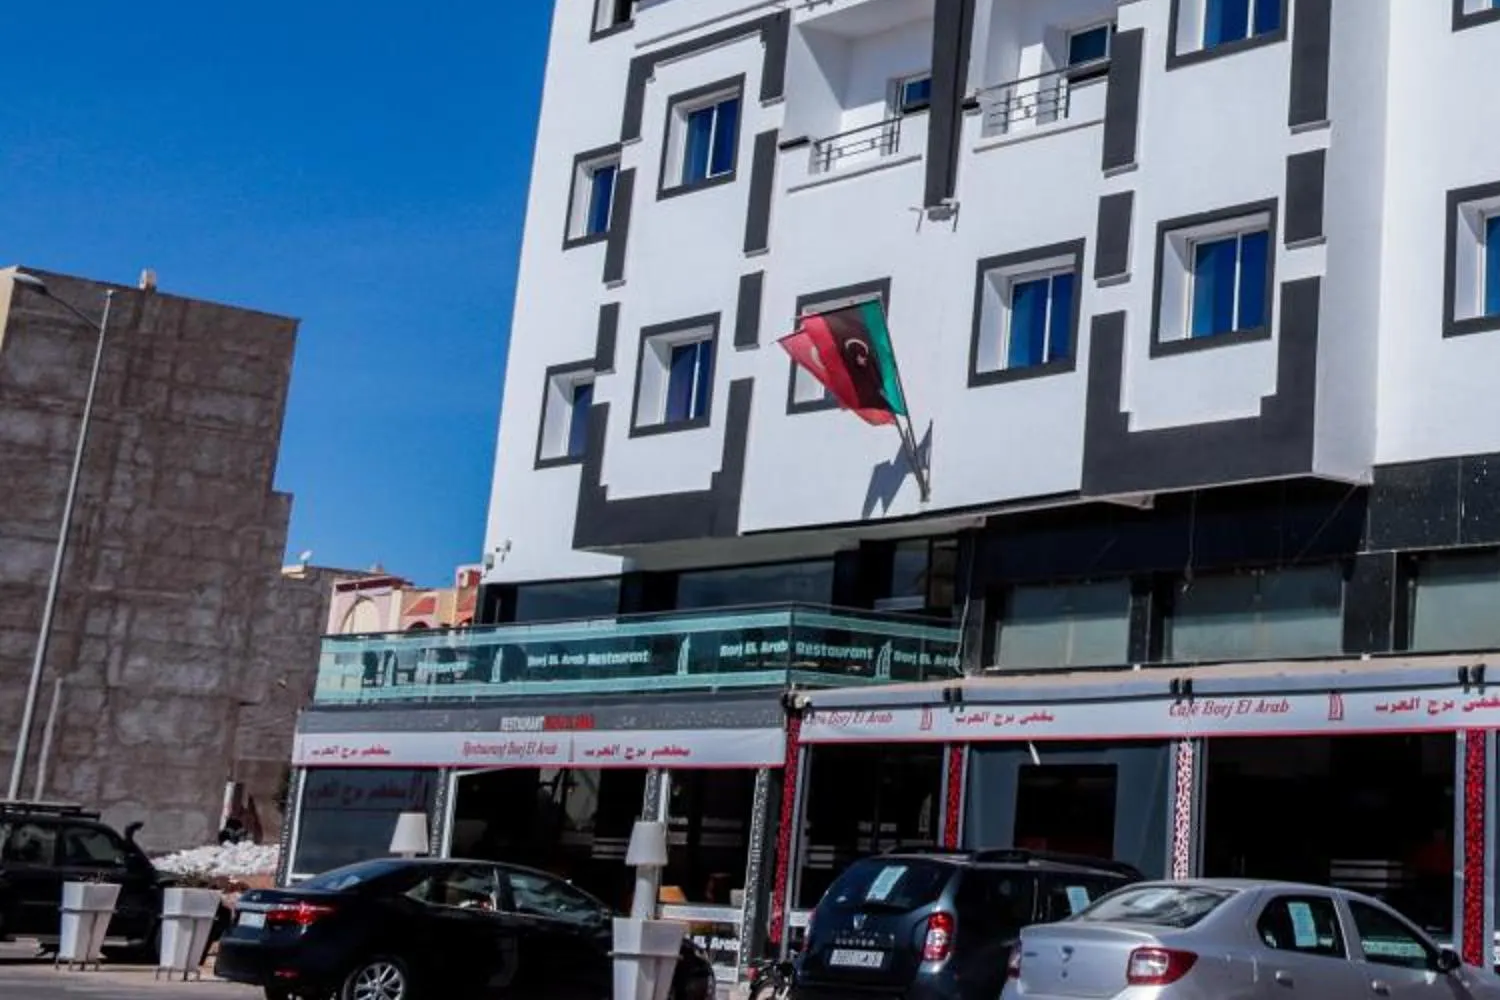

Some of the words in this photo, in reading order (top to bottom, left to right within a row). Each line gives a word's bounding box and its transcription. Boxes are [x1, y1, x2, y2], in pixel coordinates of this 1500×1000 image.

[760, 639, 789, 654] Arab
[796, 641, 874, 659] Restaurant
[1201, 699, 1234, 719] Borj
[1236, 698, 1252, 715] El
[1255, 698, 1289, 714] Arab
[1374, 695, 1422, 714] العرب
[1427, 698, 1455, 716] برج
[955, 711, 989, 725] العرب
[994, 712, 1016, 727] برج
